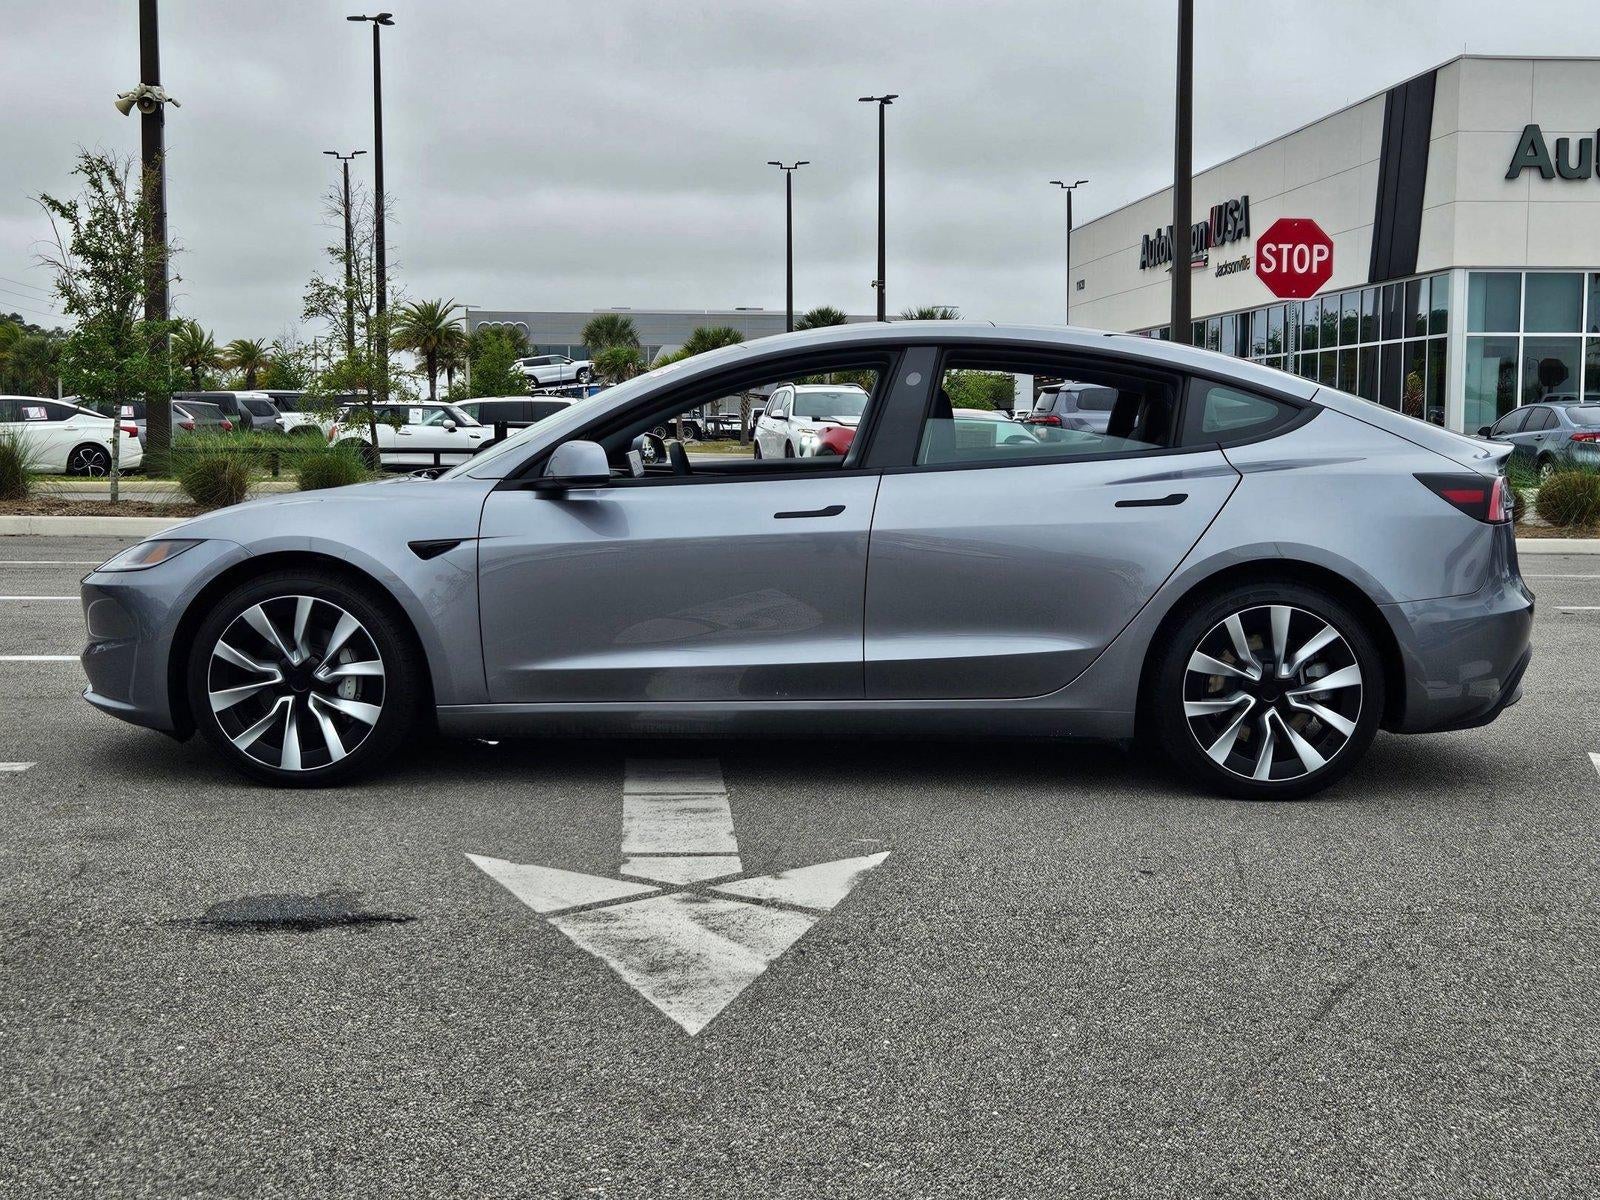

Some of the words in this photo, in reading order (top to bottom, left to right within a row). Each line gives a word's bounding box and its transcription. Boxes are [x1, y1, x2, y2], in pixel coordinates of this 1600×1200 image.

[1504, 124, 1600, 180] Au
[1139, 221, 1209, 270] AutoNon
[1260, 242, 1329, 274] STOP
